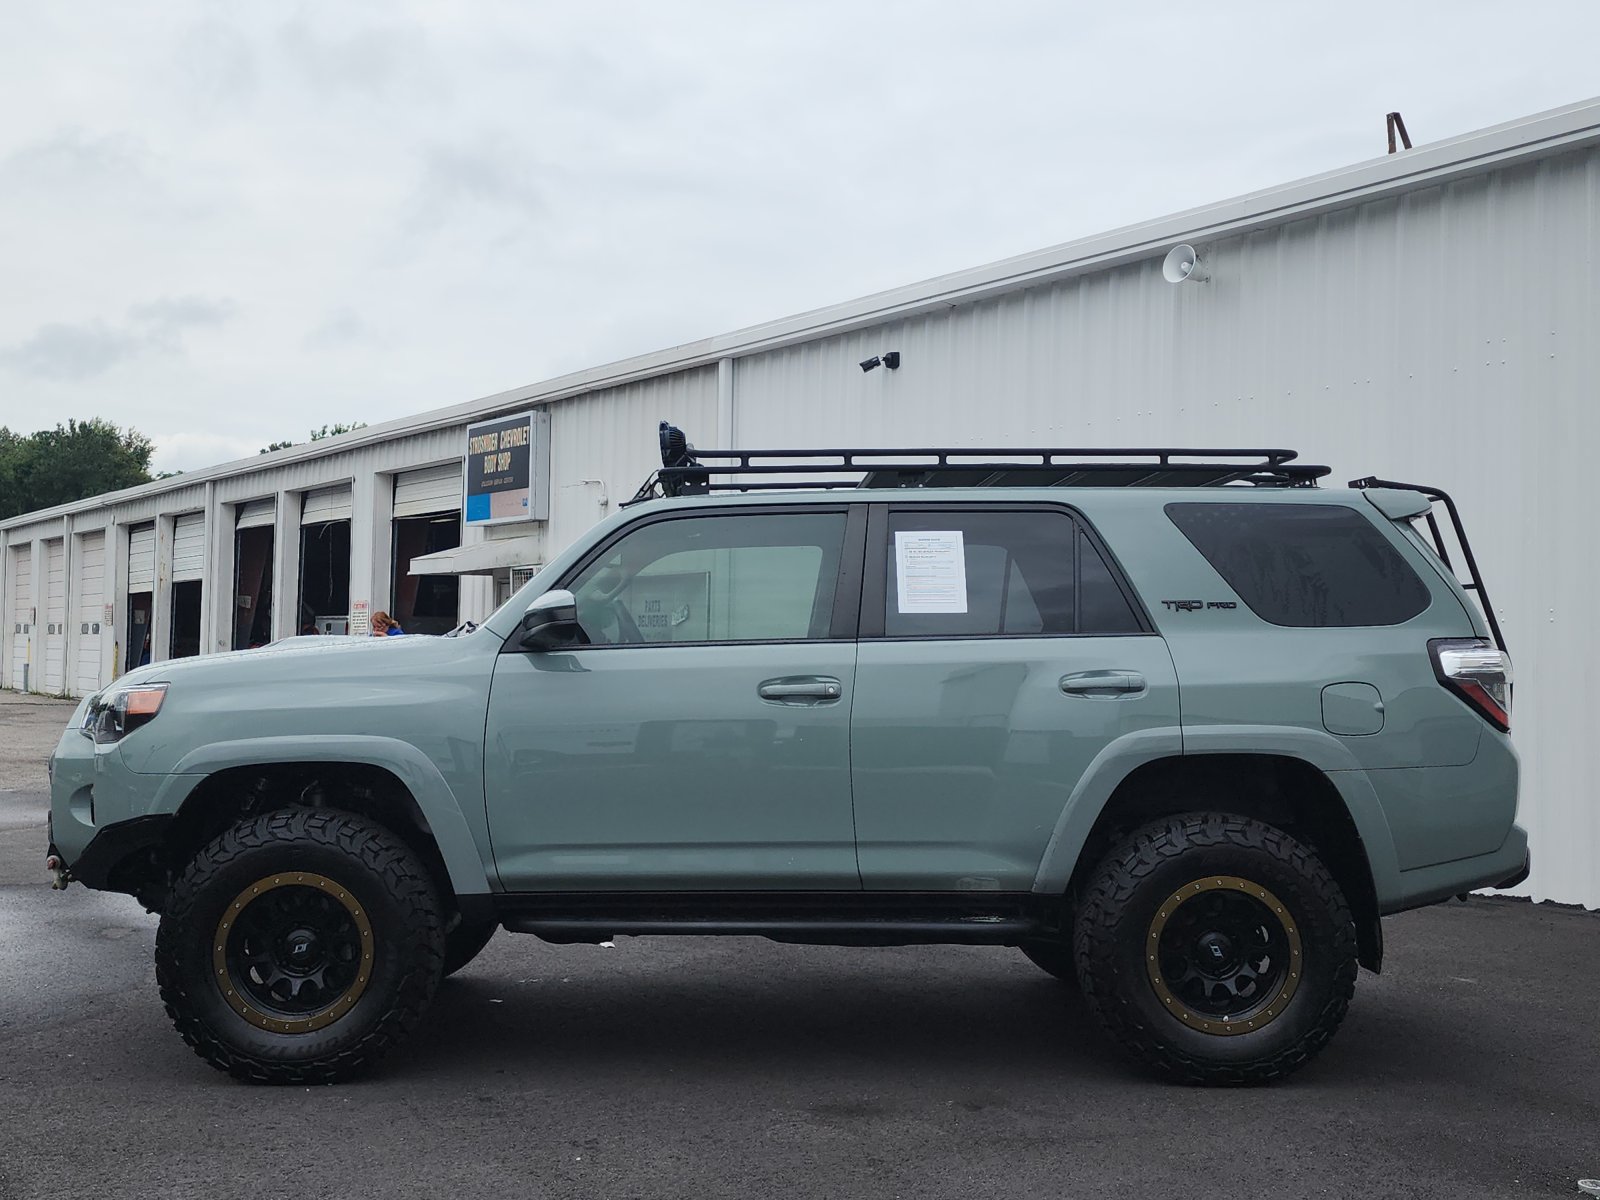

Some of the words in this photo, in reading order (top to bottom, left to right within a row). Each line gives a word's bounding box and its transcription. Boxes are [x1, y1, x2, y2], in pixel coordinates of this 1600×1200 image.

[500, 426, 530, 449] CHEVROLET
[484, 454, 497, 474] BODY
[498, 452, 511, 471] SHOP
[645, 599, 660, 613] PARTS
[1161, 600, 1203, 612] TRD
[1207, 602, 1237, 610] PRO
[638, 614, 668, 628] DELIVERIES
